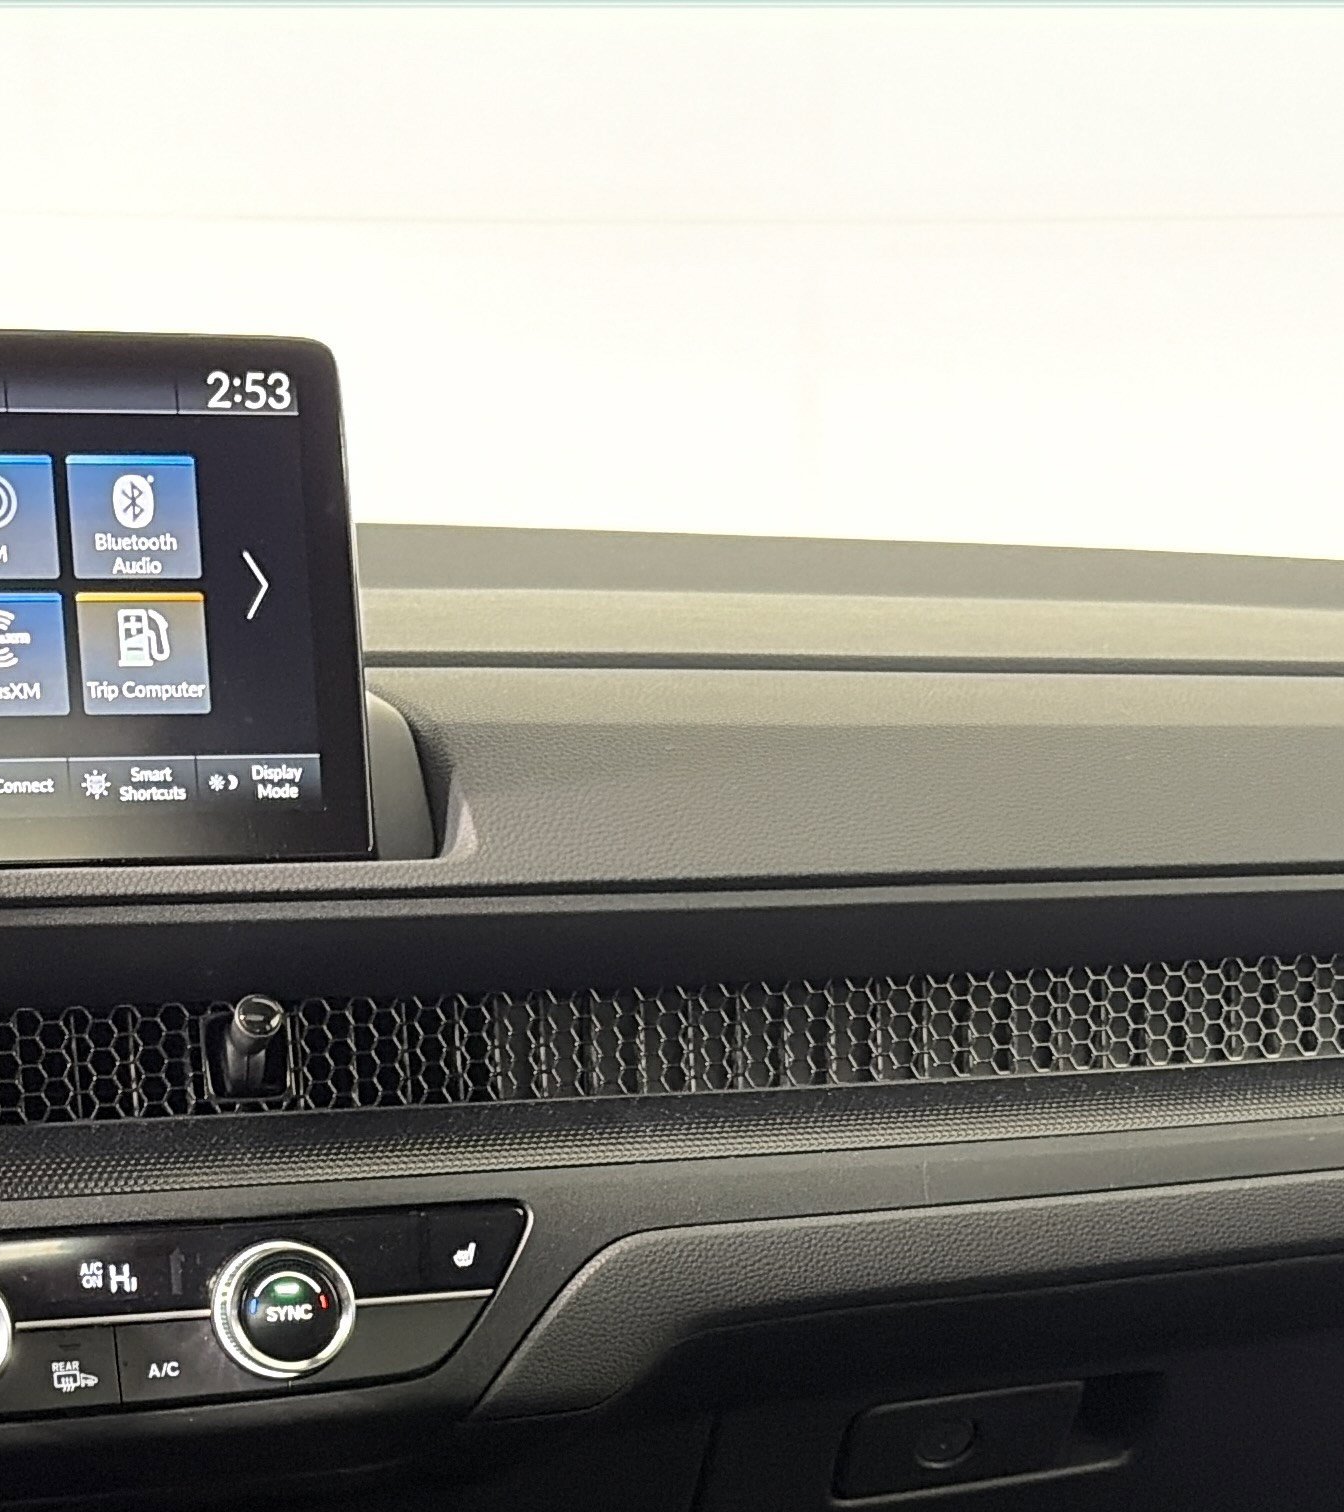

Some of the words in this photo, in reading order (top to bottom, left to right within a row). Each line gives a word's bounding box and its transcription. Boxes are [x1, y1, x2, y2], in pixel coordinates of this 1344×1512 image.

[206, 371, 292, 411] 2:53
[95, 534, 177, 552] Bluetooth
[112, 557, 162, 575] Audio
[86, 681, 119, 701] Trip
[122, 681, 206, 701] Computer
[130, 767, 173, 784] Smart
[251, 765, 303, 785] Display
[119, 785, 186, 802] Shortcuts
[257, 782, 299, 799] Mode
[79, 1261, 103, 1276] A/C
[81, 1275, 102, 1289] ON
[266, 1303, 313, 1323] SYNC
[51, 1361, 80, 1372] REAR
[148, 1361, 180, 1380] A/C
